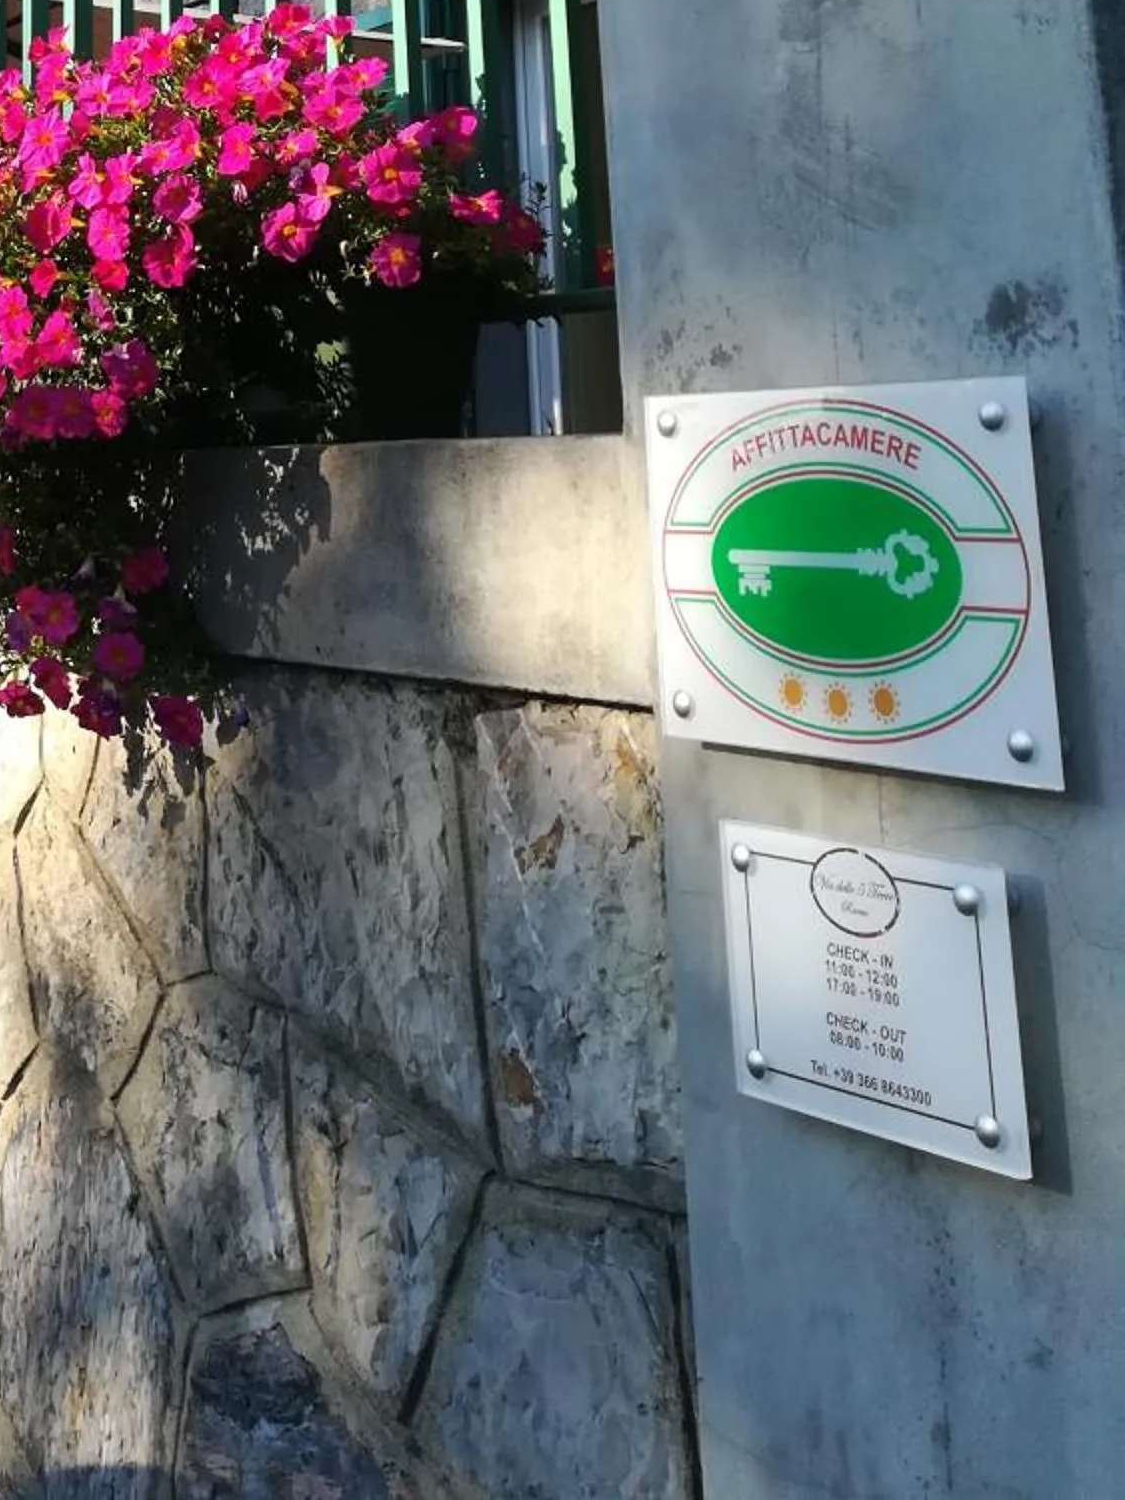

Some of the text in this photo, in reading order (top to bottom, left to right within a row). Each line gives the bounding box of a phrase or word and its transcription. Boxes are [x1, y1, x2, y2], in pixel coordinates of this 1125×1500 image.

[729, 422, 923, 473] AFFITTACAMERE
[826, 941, 870, 965] CHECK
[879, 952, 895, 969] IN
[866, 969, 898, 989] 12:00
[826, 1011, 869, 1035] CHECK
[880, 1025, 907, 1045] OUT
[833, 1067, 854, 1085] +39
